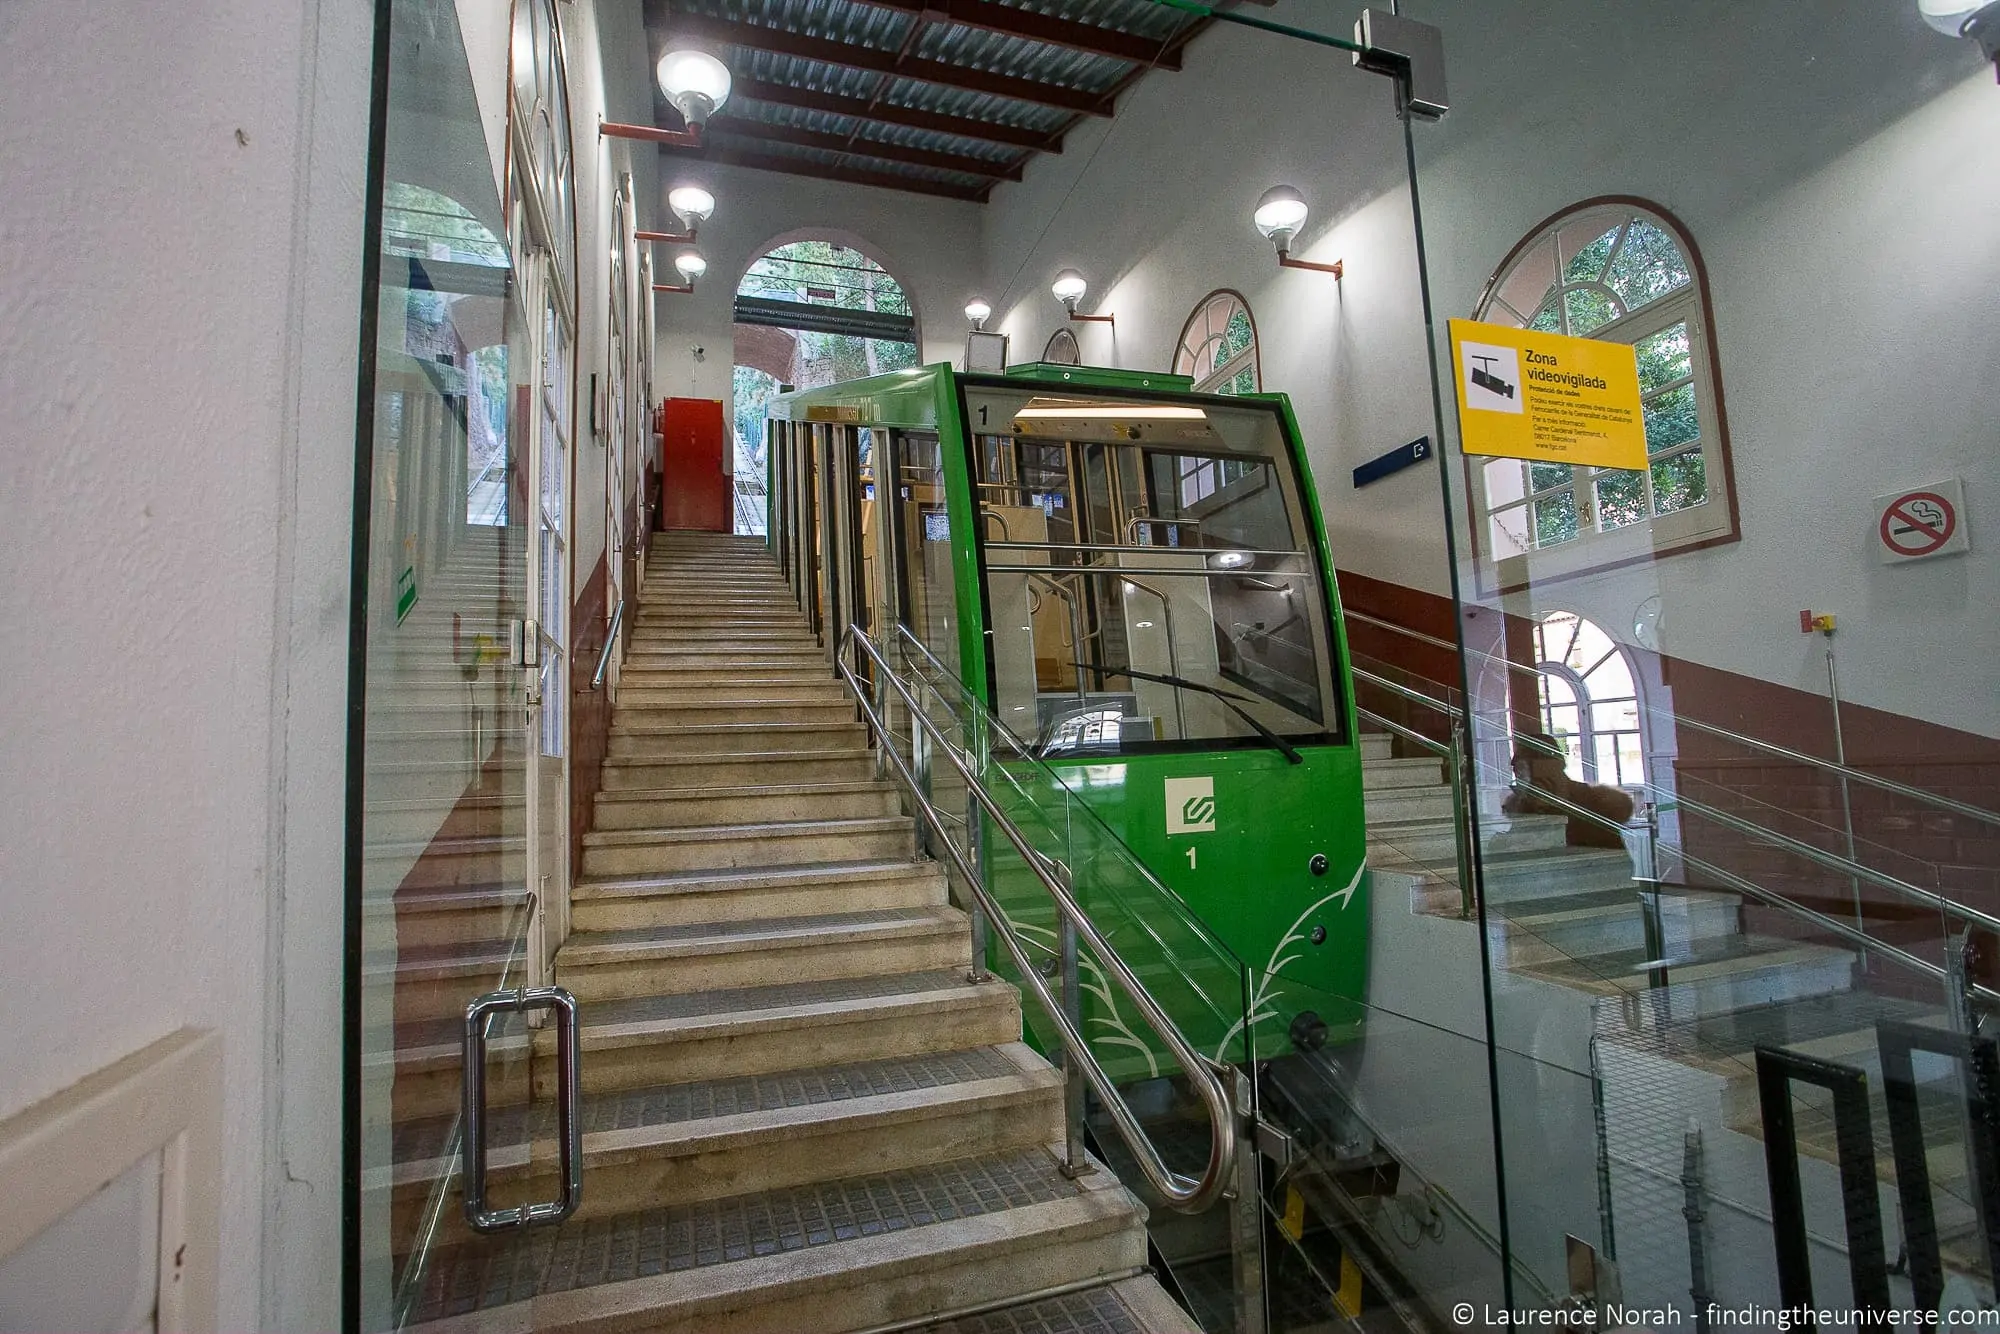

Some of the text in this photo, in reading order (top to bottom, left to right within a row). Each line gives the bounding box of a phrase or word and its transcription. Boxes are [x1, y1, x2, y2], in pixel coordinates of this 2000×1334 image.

[1525, 349, 1558, 366] Zona
[1527, 367, 1607, 390] videovigilada
[978, 404, 988, 425] 1
[1185, 846, 1197, 870] 1
